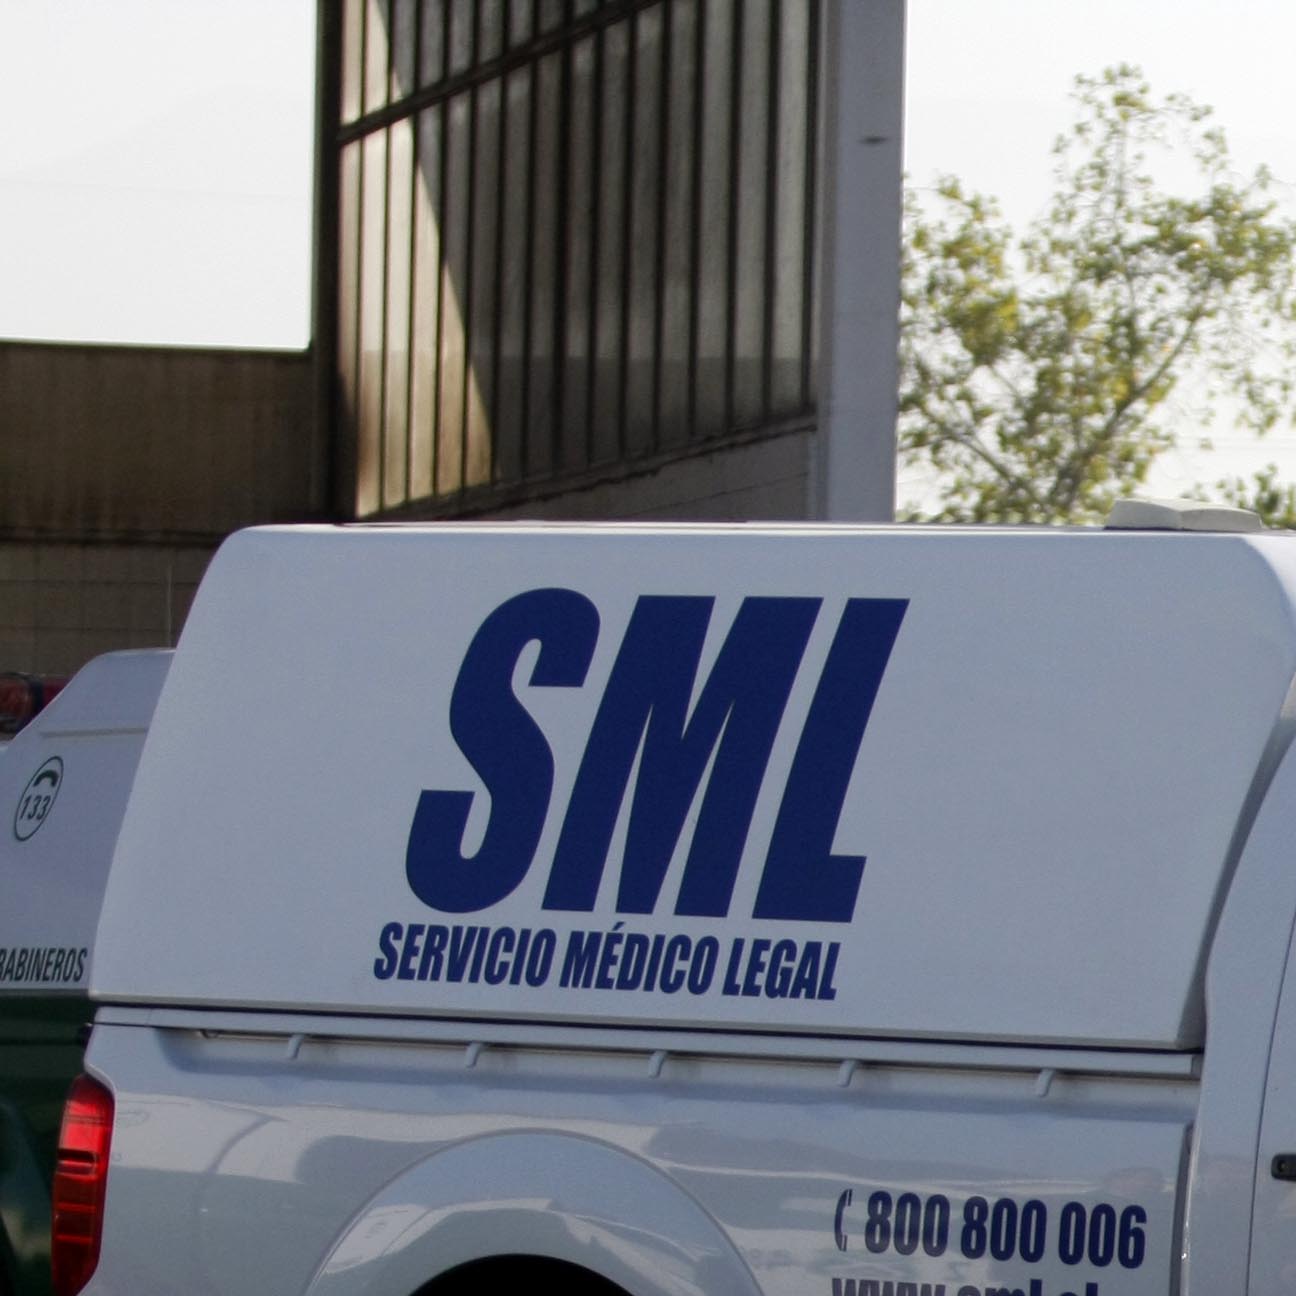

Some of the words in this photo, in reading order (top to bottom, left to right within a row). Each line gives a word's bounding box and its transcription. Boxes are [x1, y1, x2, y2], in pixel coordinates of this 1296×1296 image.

[405, 587, 910, 923] SML
[20, 795, 51, 820] 133
[373, 922, 557, 987] SERVICIO
[559, 921, 720, 995] MÉDICO
[721, 937, 841, 1000] LEGAL
[865, 1190, 950, 1257] 800
[961, 1196, 1047, 1263] 800
[1058, 1201, 1147, 1269] 006
